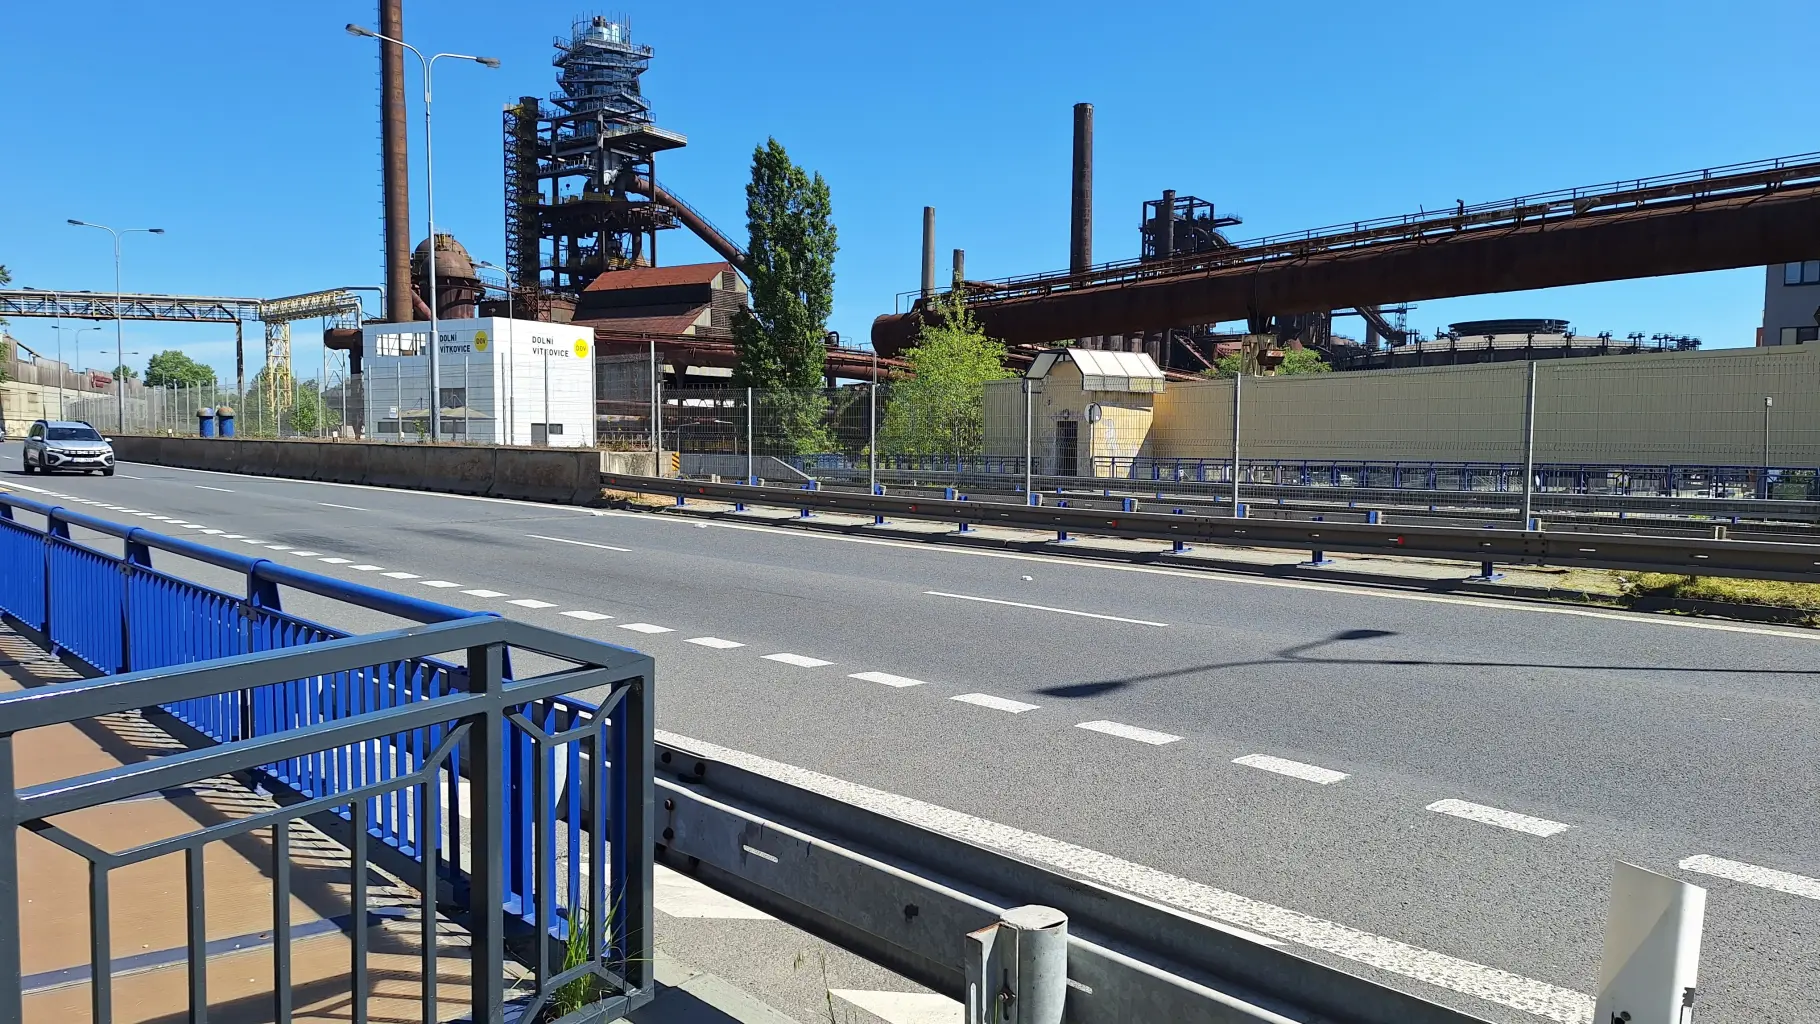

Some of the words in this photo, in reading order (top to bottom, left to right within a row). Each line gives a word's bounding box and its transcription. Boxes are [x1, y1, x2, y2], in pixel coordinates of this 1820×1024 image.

[439, 332, 457, 342] DOLNÍ
[532, 335, 554, 345] DOLNÍ
[439, 344, 471, 353] VÍTKOVICE
[532, 346, 569, 357] VÍTOVICE
